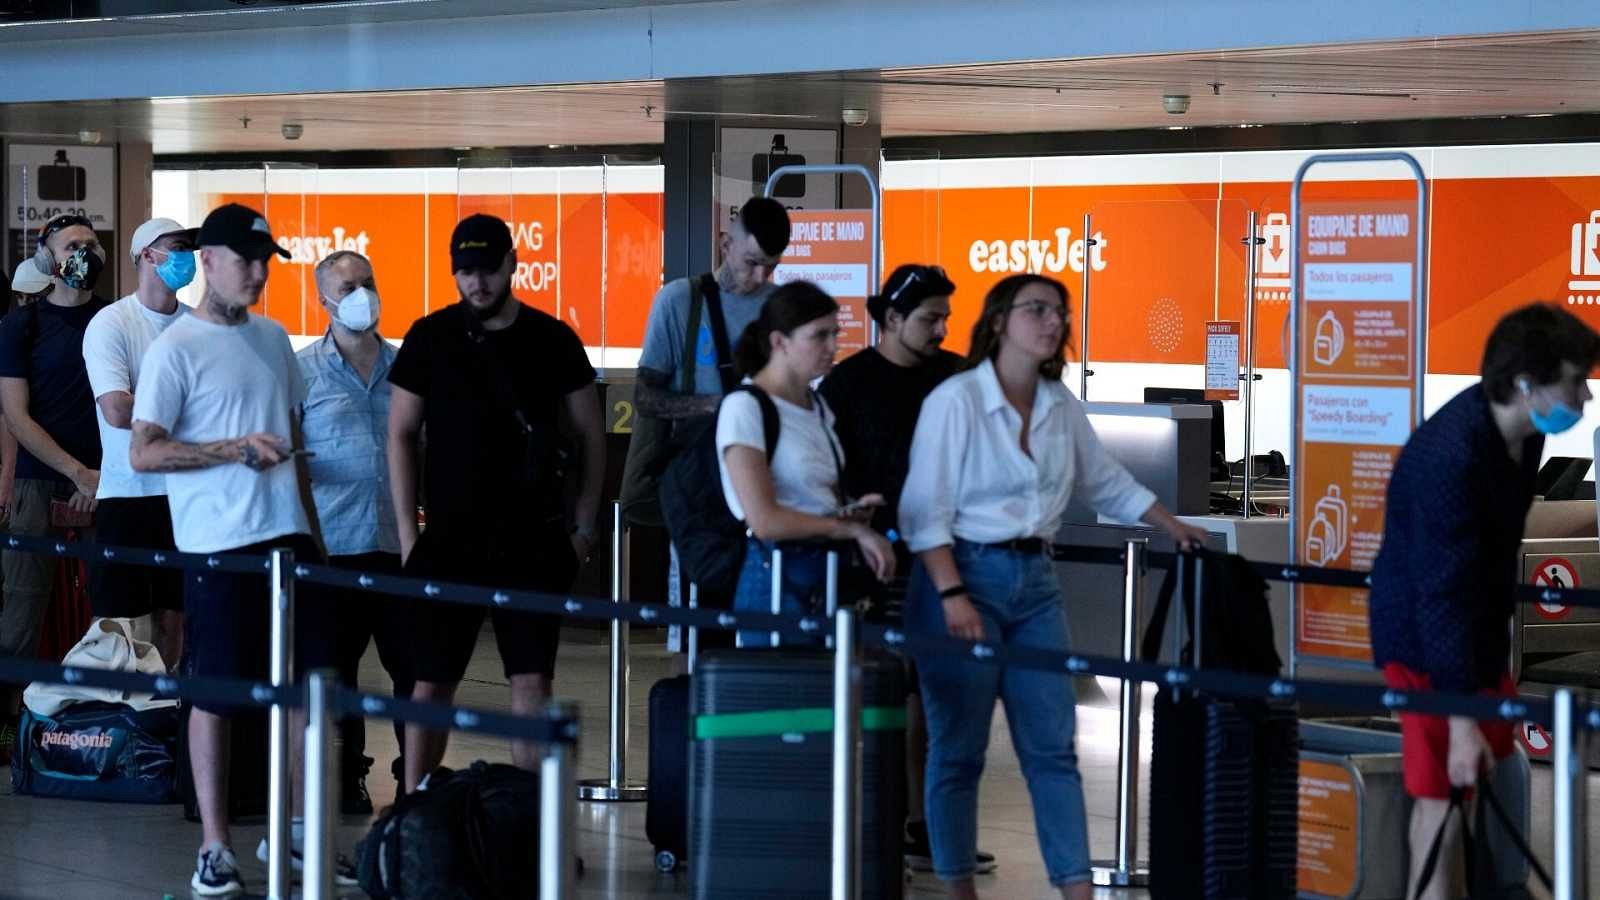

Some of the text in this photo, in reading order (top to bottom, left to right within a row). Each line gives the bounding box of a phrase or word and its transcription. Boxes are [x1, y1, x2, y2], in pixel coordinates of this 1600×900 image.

[790, 221, 864, 241] UIPAJE DE MANO
[1359, 214, 1374, 237] DE
[1376, 213, 1409, 237] MANO
[969, 227, 1107, 274] easyJet
[1309, 269, 1334, 282] Todos
[1308, 395, 1350, 408] Pasajeros
[613, 401, 633, 434] 2
[41, 731, 113, 750] patagonia
